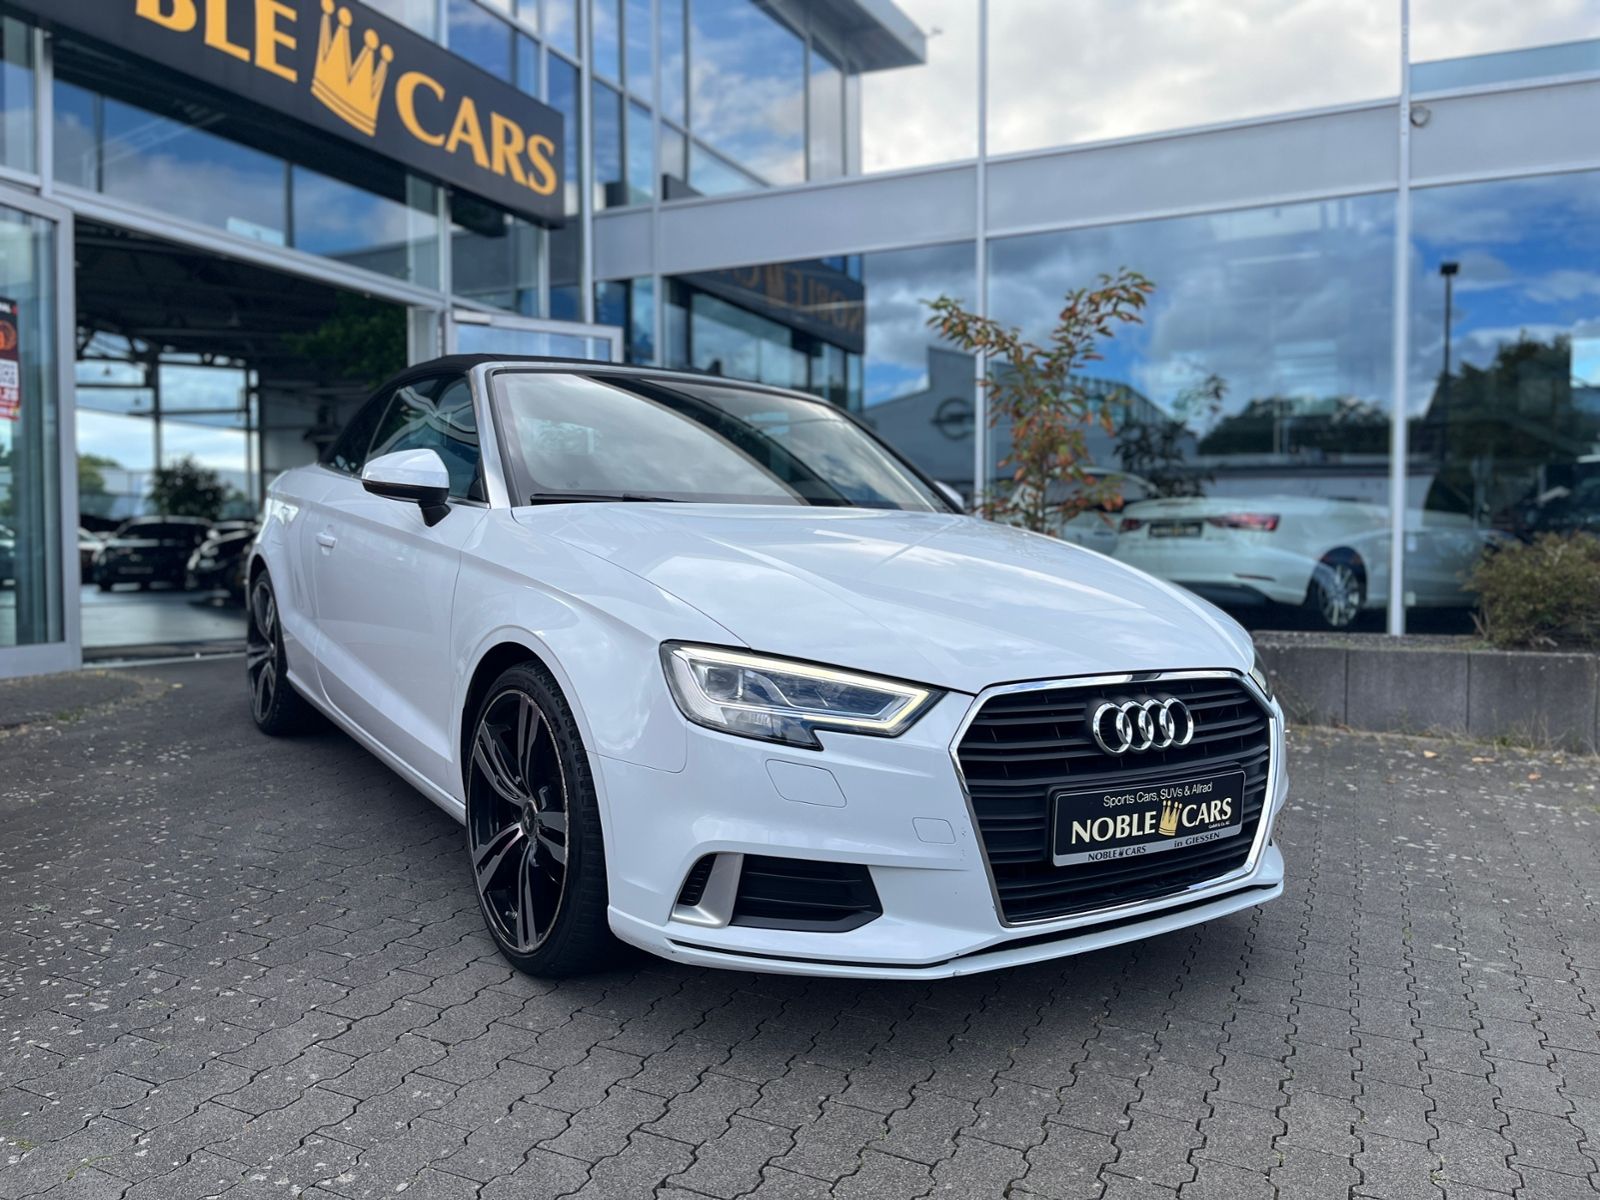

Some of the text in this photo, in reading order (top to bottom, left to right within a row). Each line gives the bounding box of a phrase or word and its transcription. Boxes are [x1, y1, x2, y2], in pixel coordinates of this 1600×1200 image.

[395, 71, 557, 196] CARS
[1103, 781, 1213, 808] Sports Cars, SUVs & Allrad
[1071, 797, 1232, 844] NOBLE CARS
[1088, 845, 1147, 861] NOBLE CARS
[1174, 832, 1220, 848] in GIESSEN
